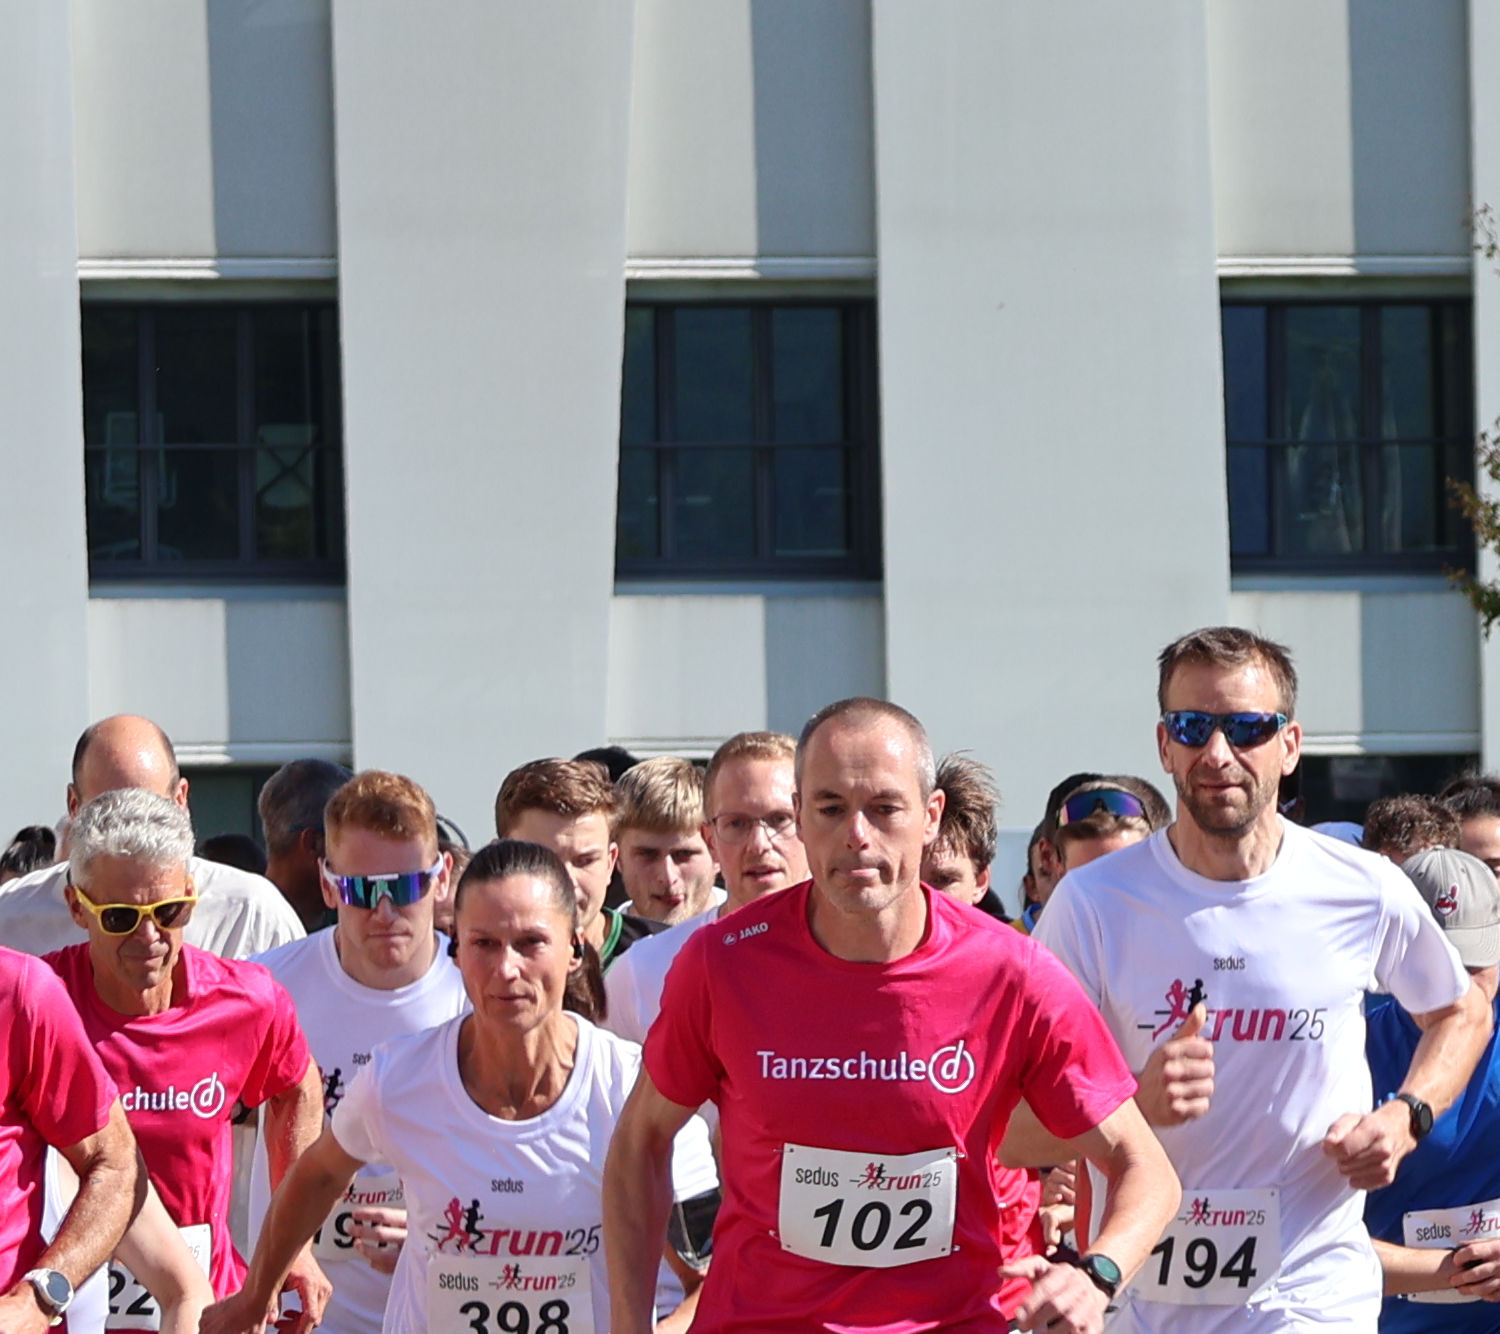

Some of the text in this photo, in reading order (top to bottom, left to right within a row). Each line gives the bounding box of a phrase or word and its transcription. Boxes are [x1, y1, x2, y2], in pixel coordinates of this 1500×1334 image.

[739, 921, 769, 940] JAKO
[1213, 955, 1245, 970] sedus
[491, 1177, 524, 1193] sedus
[795, 1166, 840, 1188] sedus
[813, 1198, 933, 1251] 102
[1416, 1223, 1451, 1242] sedus
[1151, 1236, 1257, 1289] 194
[439, 1272, 479, 1291] sedus
